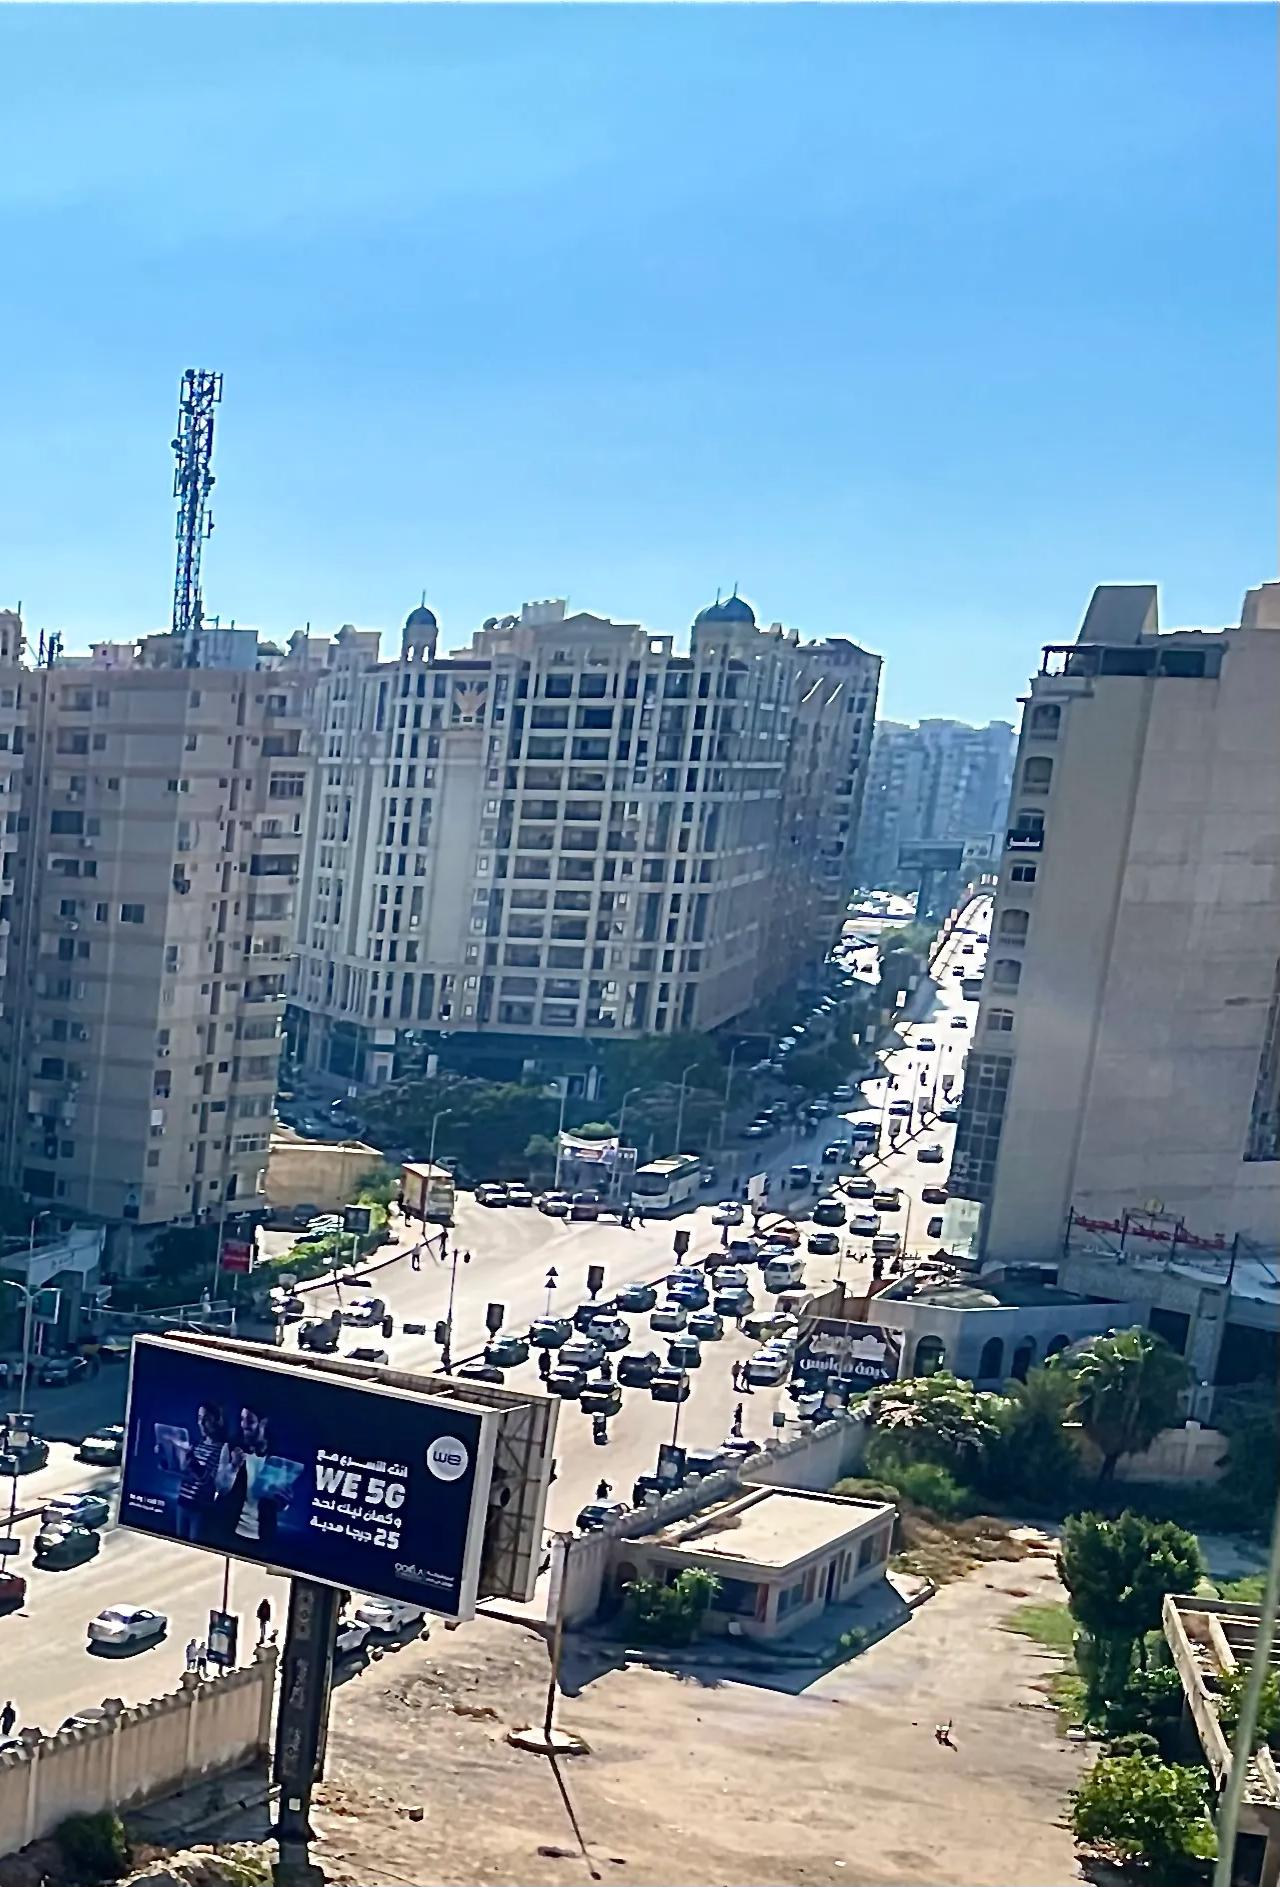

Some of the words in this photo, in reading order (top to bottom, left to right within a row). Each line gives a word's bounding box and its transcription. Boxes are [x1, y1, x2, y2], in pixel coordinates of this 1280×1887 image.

[316, 1449, 339, 1462] مع
[315, 1464, 362, 1500] WE
[364, 1477, 406, 1509] 5G
[311, 1497, 336, 1511] لحد
[336, 1503, 363, 1519] ليك
[309, 1515, 344, 1532] هدية
[345, 1524, 372, 1543] جيجا
[373, 1527, 401, 1550] 25
